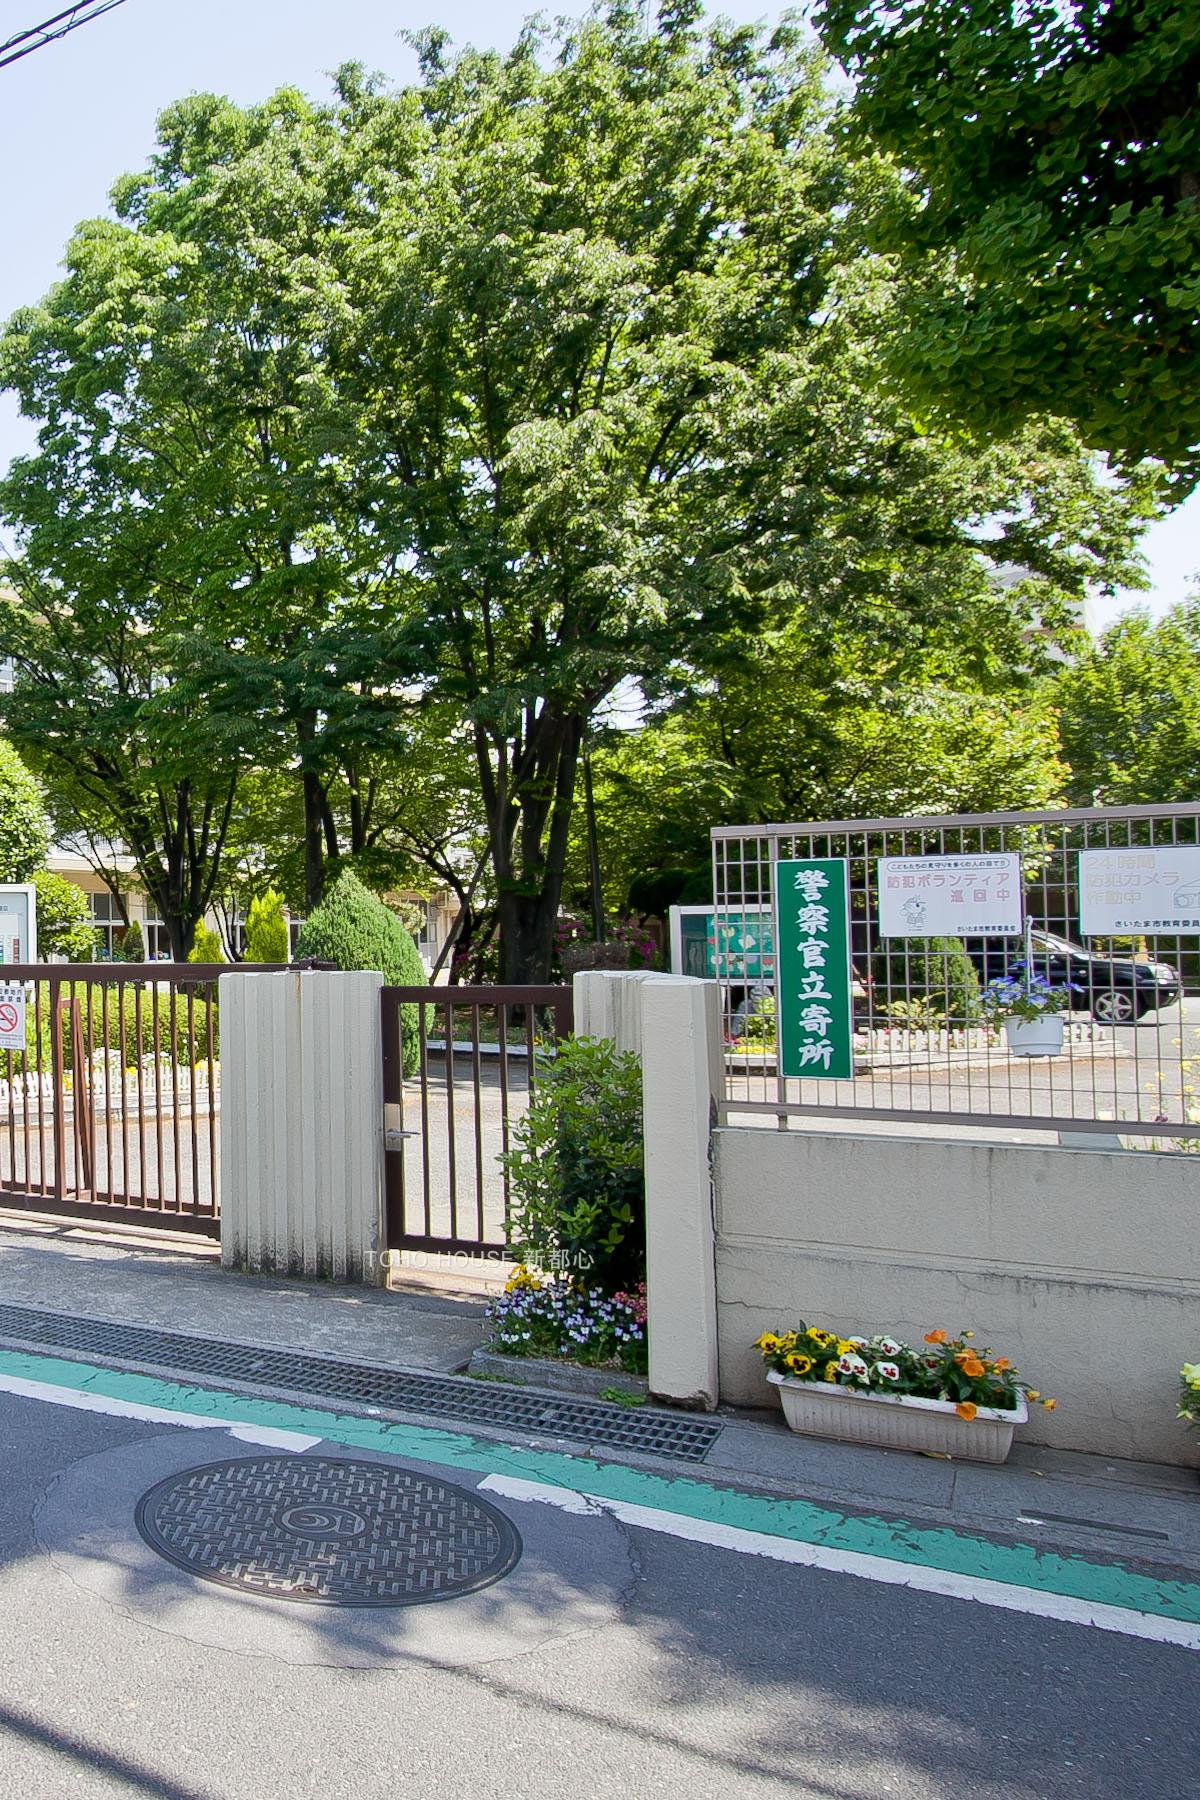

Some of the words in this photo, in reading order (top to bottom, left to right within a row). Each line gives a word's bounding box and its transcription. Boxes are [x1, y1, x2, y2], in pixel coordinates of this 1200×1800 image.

[887, 872, 1010, 889] 防犯ボランティア
[1087, 871, 1180, 887] 防犯カメラ
[1087, 889, 1142, 905] 作動中
[793, 869, 834, 1070] 警察官立寄所
